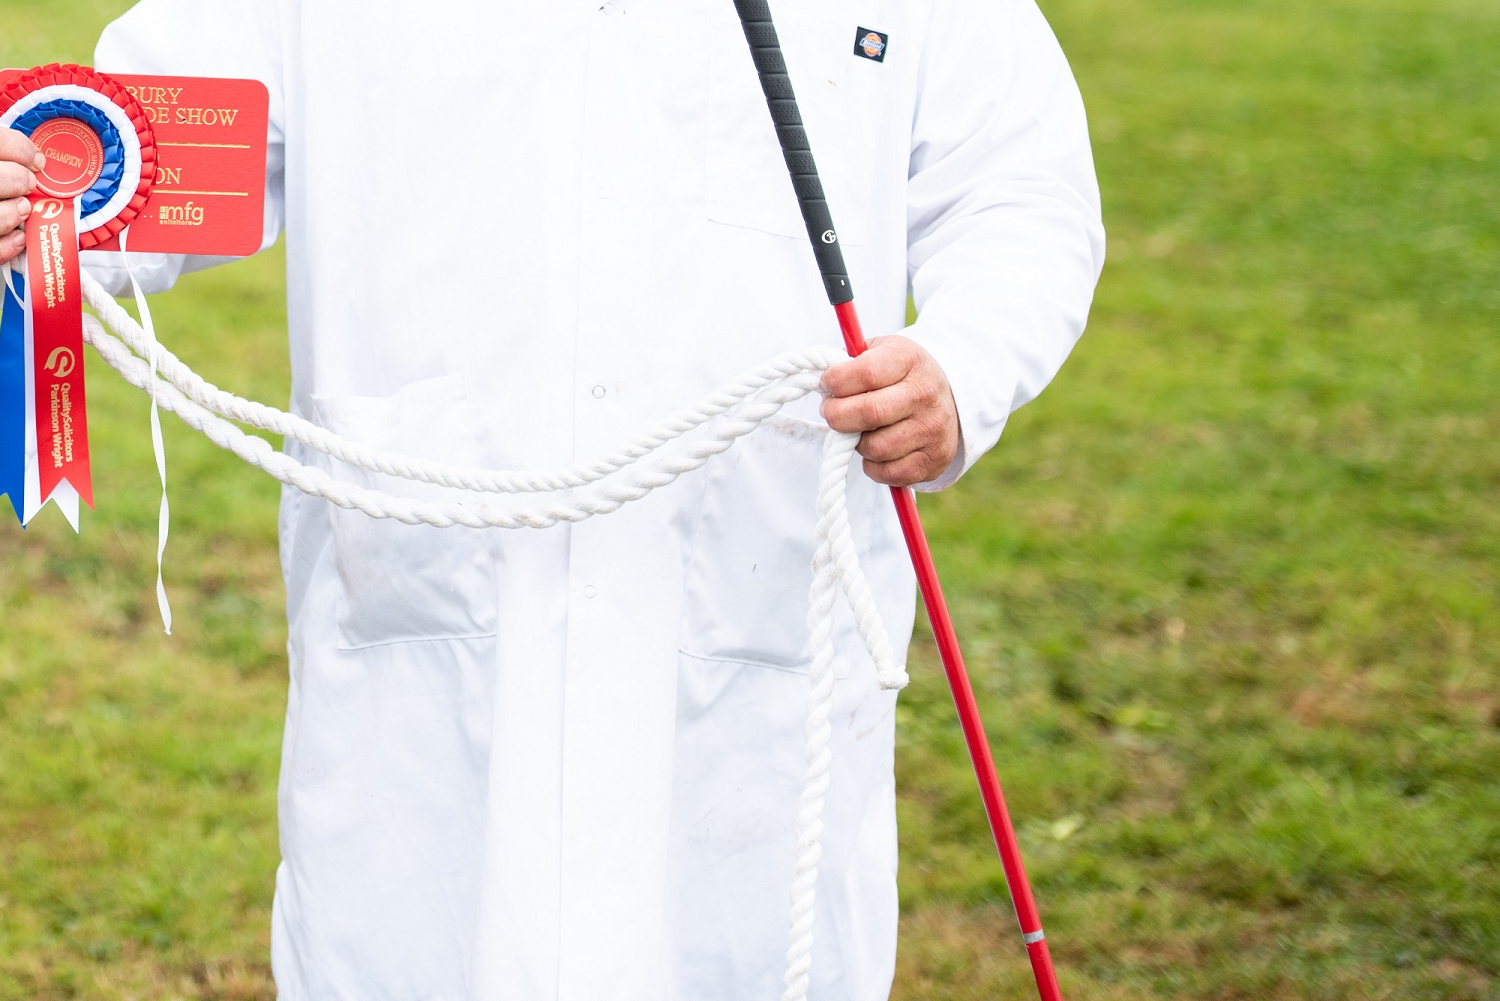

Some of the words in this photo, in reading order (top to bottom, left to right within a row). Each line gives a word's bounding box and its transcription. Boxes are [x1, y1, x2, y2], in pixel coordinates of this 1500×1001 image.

[125, 86, 183, 104] BURY
[175, 107, 239, 126] SHOW
[45, 147, 83, 169] CHAMPION
[87, 154, 98, 177] SHOW
[165, 201, 205, 226] mfg
[39, 225, 51, 272] Parkinson
[49, 222, 66, 303] QualitySolicitors
[44, 273, 57, 308] Wright
[51, 384, 60, 432] Parkinson
[61, 382, 73, 462] QualitySolicitors
[52, 433, 63, 468] Wright
